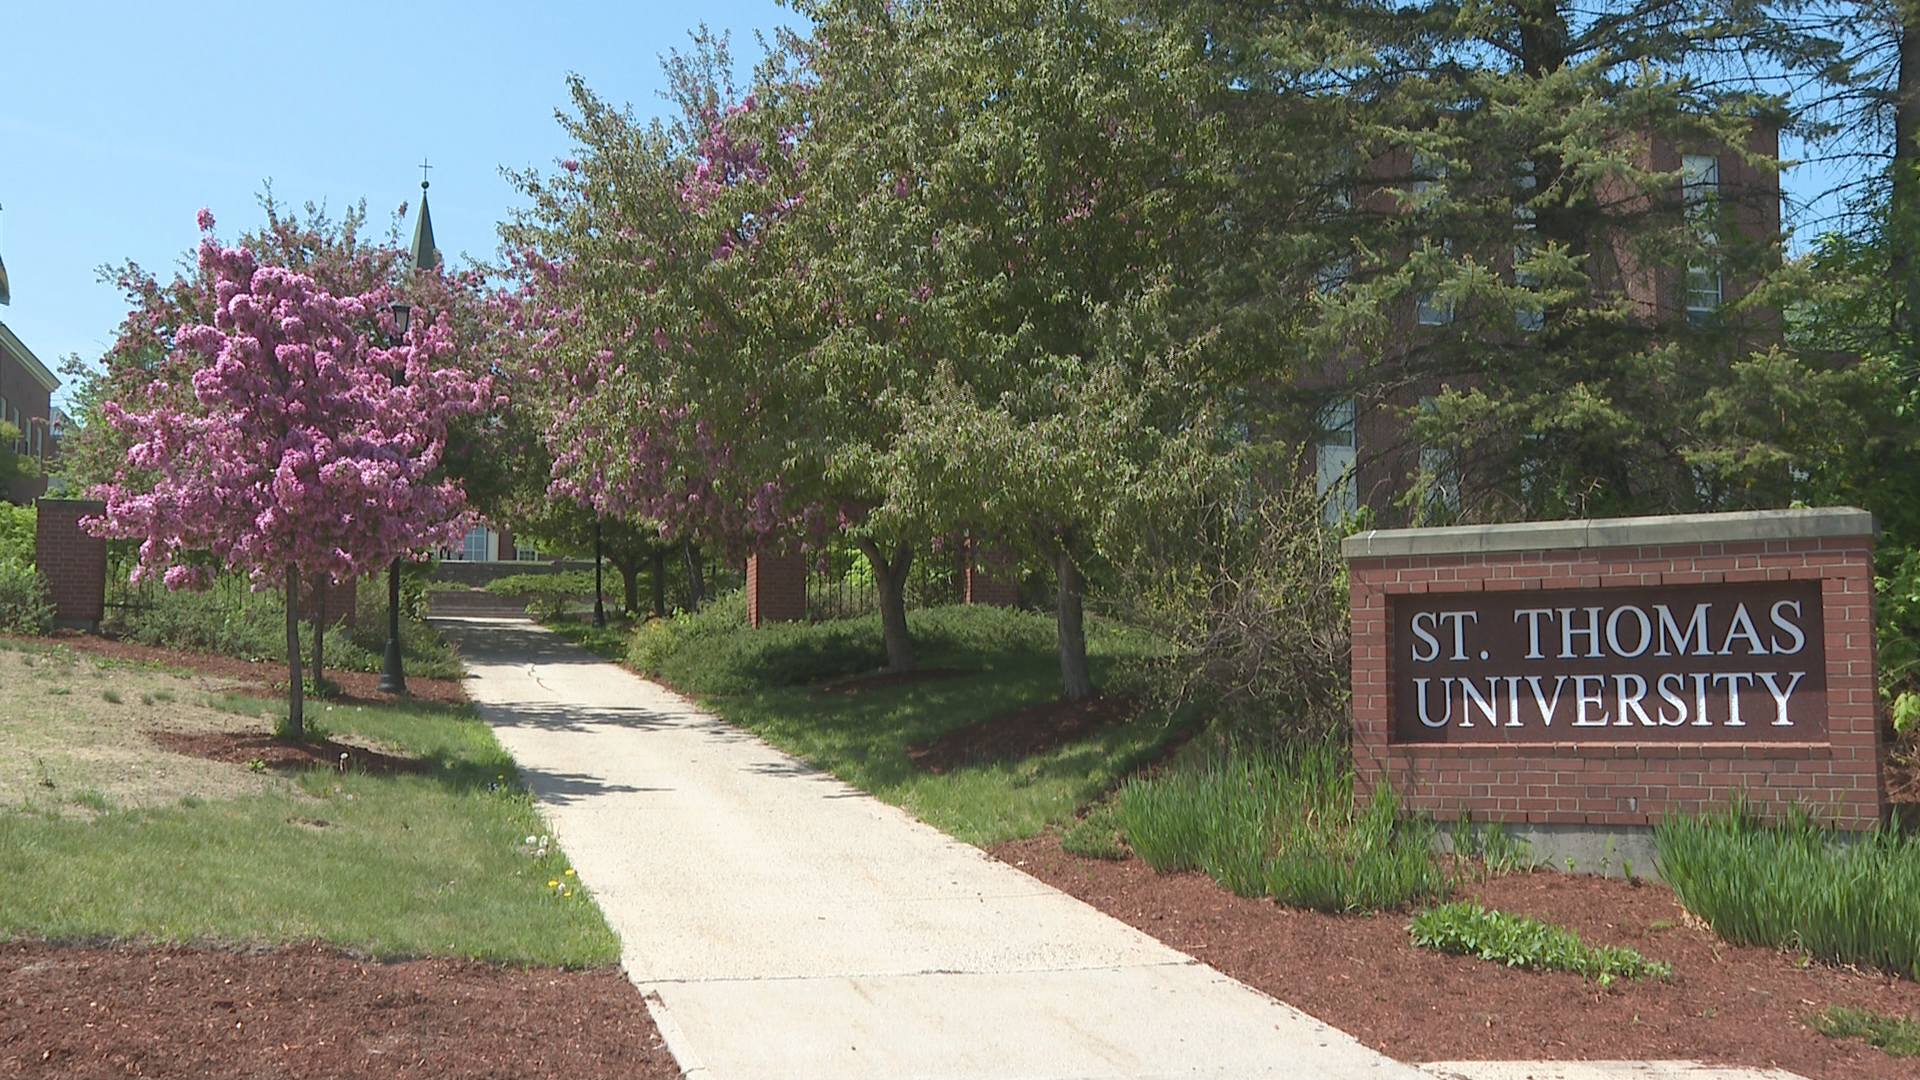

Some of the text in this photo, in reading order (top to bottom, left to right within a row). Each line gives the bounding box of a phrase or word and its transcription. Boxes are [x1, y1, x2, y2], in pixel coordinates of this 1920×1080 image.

[1411, 600, 1806, 661] ST. THOMAS
[1412, 671, 1806, 728] UNIVERSITY
